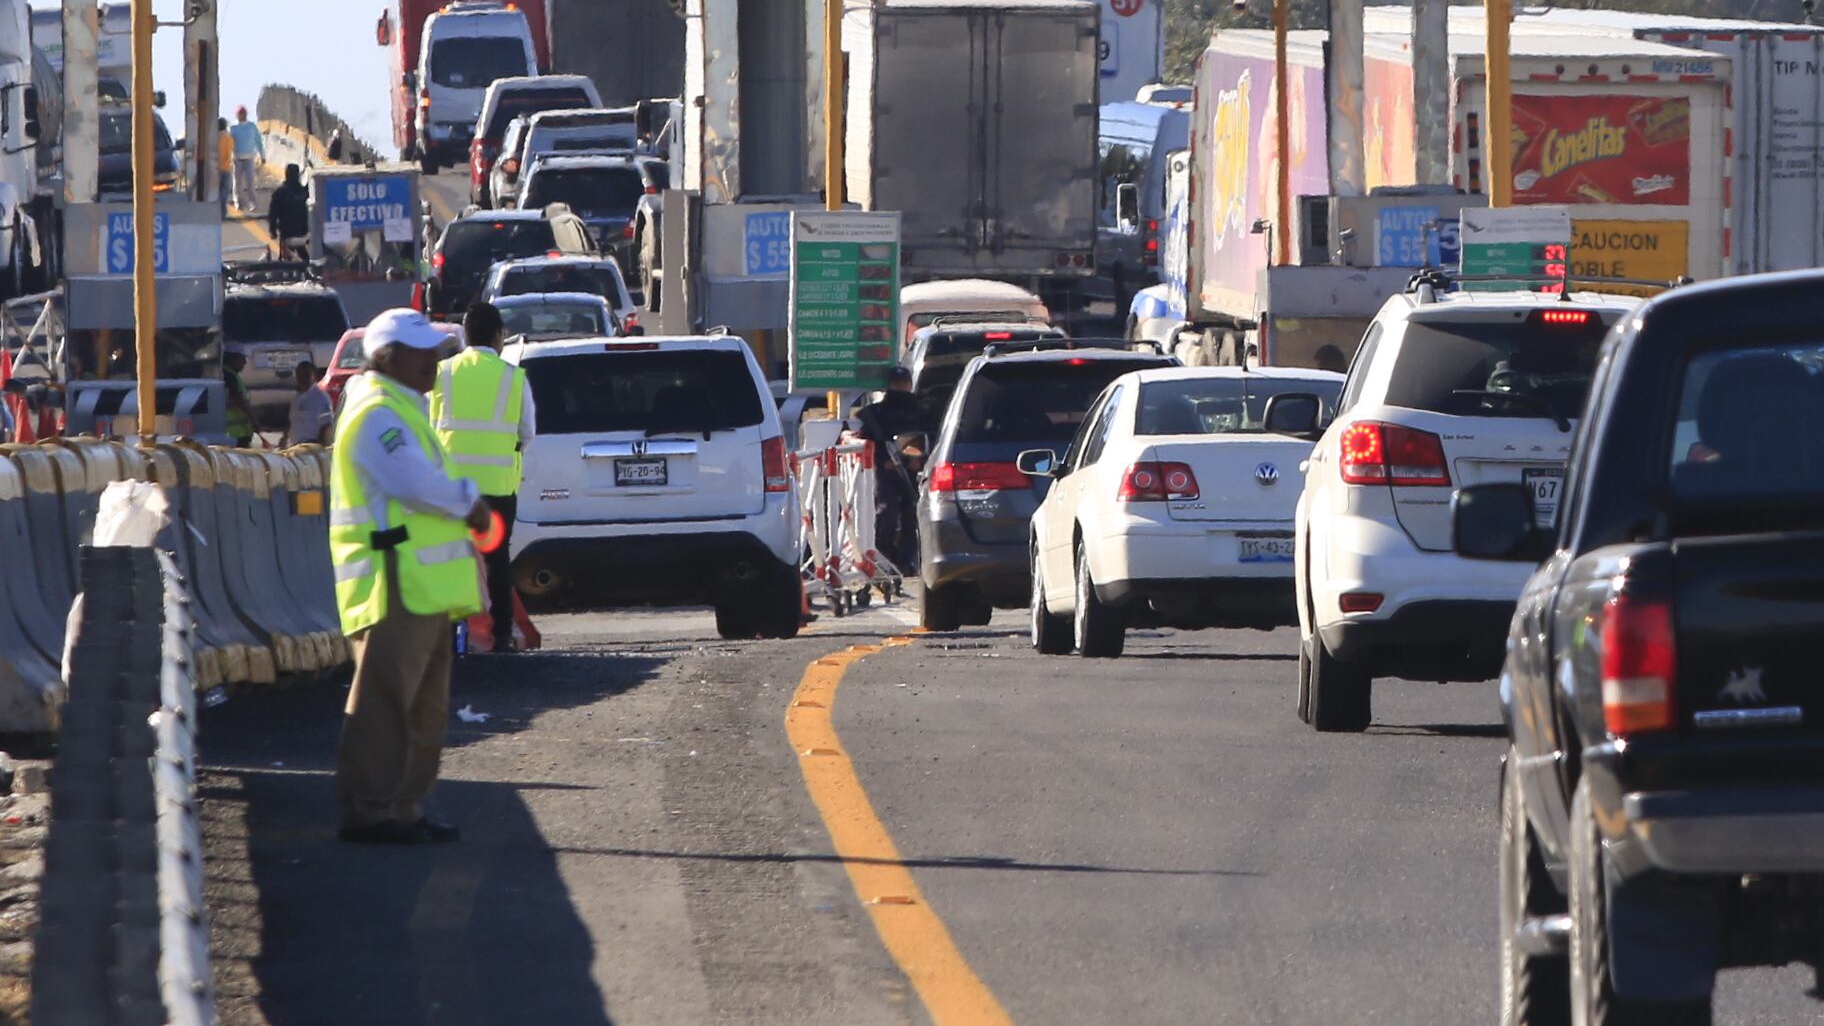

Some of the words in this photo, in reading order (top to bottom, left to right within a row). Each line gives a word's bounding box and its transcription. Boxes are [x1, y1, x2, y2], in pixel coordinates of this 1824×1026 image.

[1774, 61, 1799, 75] TIP
[1541, 116, 1628, 178] Canelitas
[347, 183, 387, 201] SOLO
